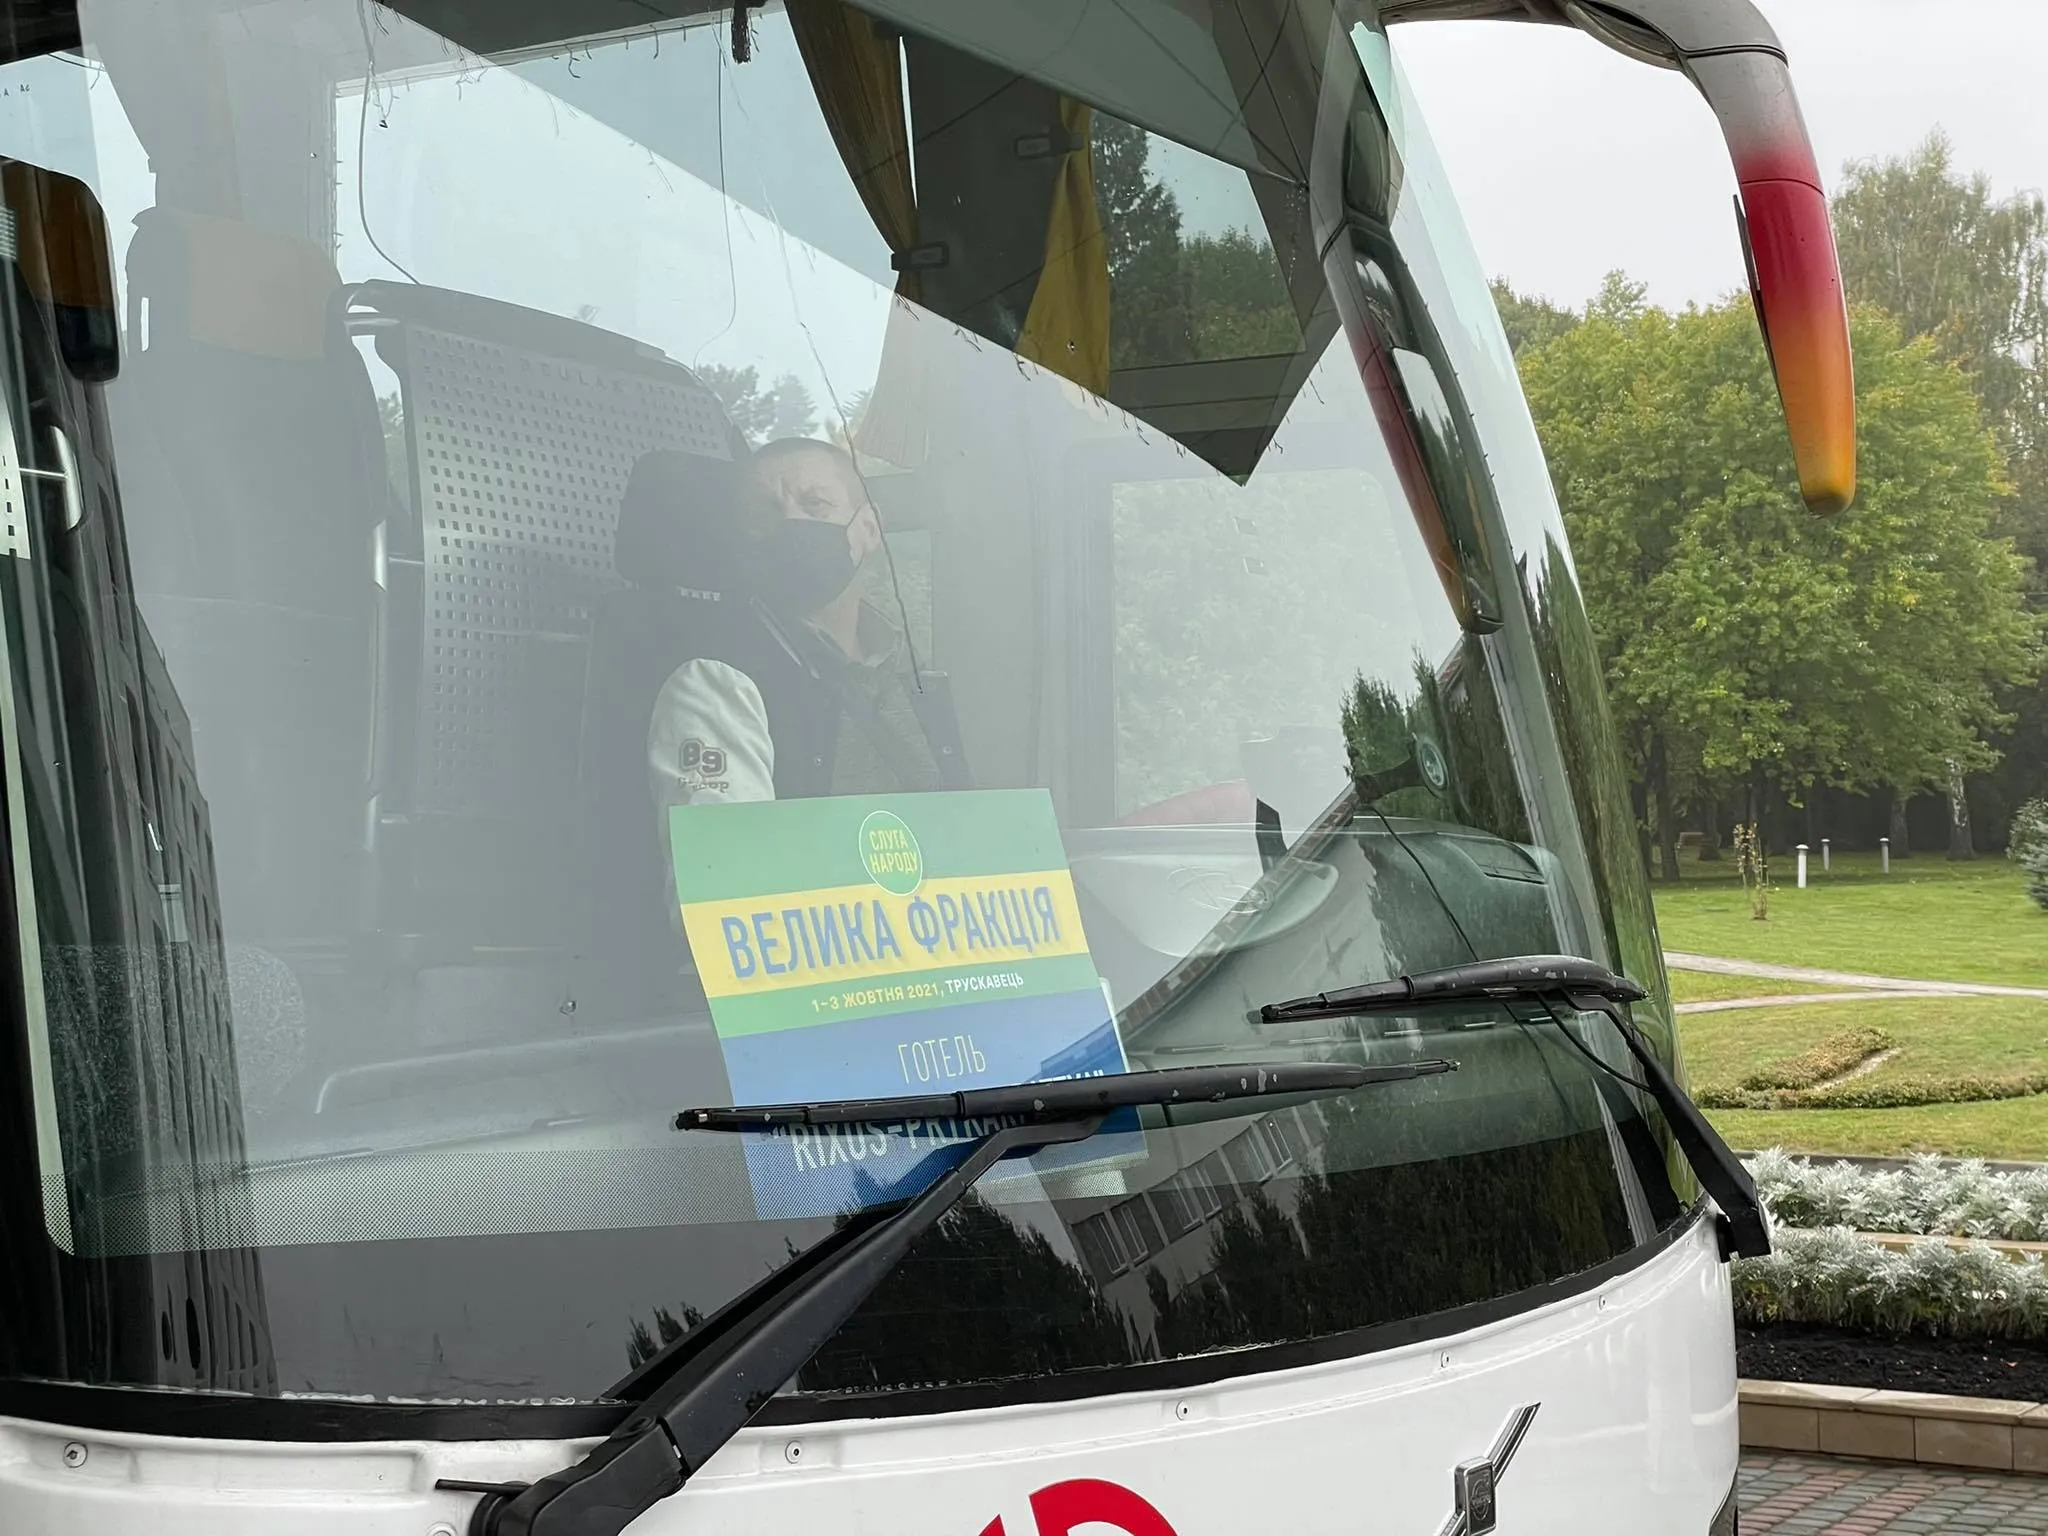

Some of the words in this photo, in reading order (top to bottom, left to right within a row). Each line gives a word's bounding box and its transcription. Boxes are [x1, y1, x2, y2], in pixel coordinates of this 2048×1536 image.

[869, 829, 908, 851] СЛУГА
[869, 851, 918, 876] НАРОДУ
[720, 899, 901, 979] ВЕЛИКА
[907, 886, 1060, 953] ФРАКЦІЯ
[843, 987, 904, 1008] ЖОВТНЯ
[908, 982, 945, 999] 2021,
[945, 972, 1024, 994] ТРУСКАВЕЦЬ
[898, 1034, 986, 1084] ГОТЕЛЬ
